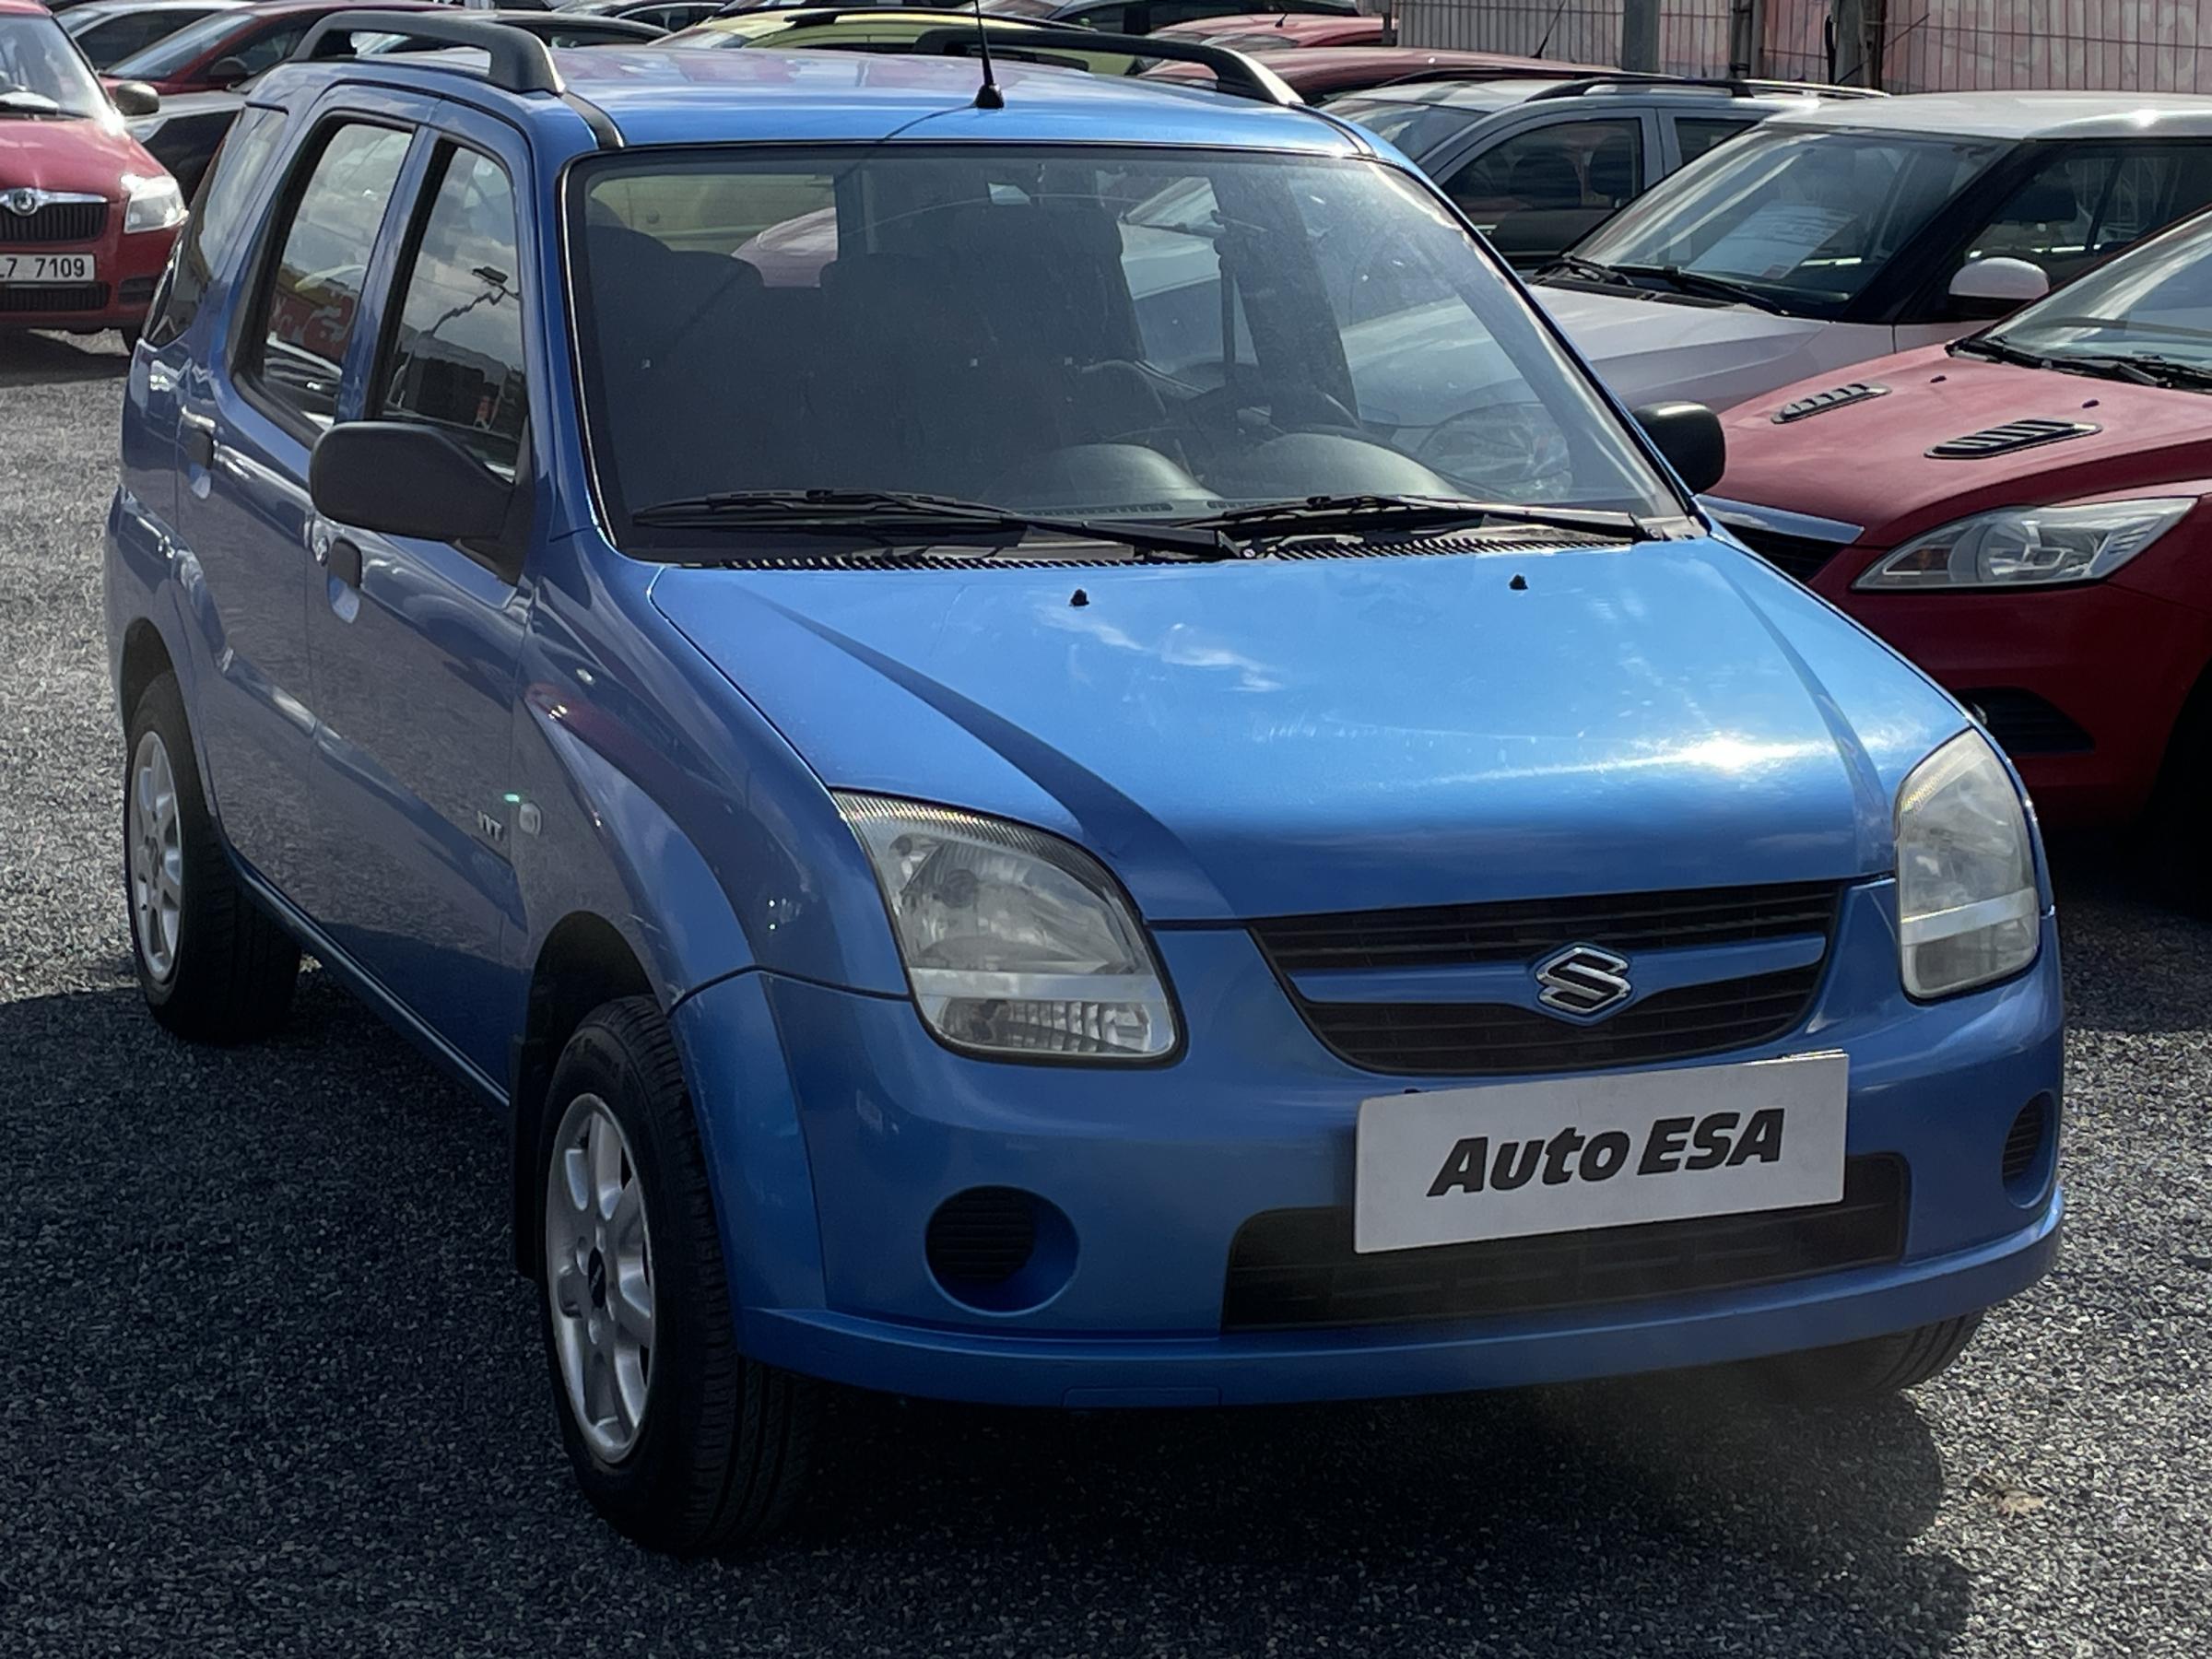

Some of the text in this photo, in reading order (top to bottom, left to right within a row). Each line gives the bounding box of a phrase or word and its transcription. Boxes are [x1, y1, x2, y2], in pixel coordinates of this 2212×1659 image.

[0, 257, 85, 278] 7 7109
[1426, 1108, 1785, 1197] Auto ESA
